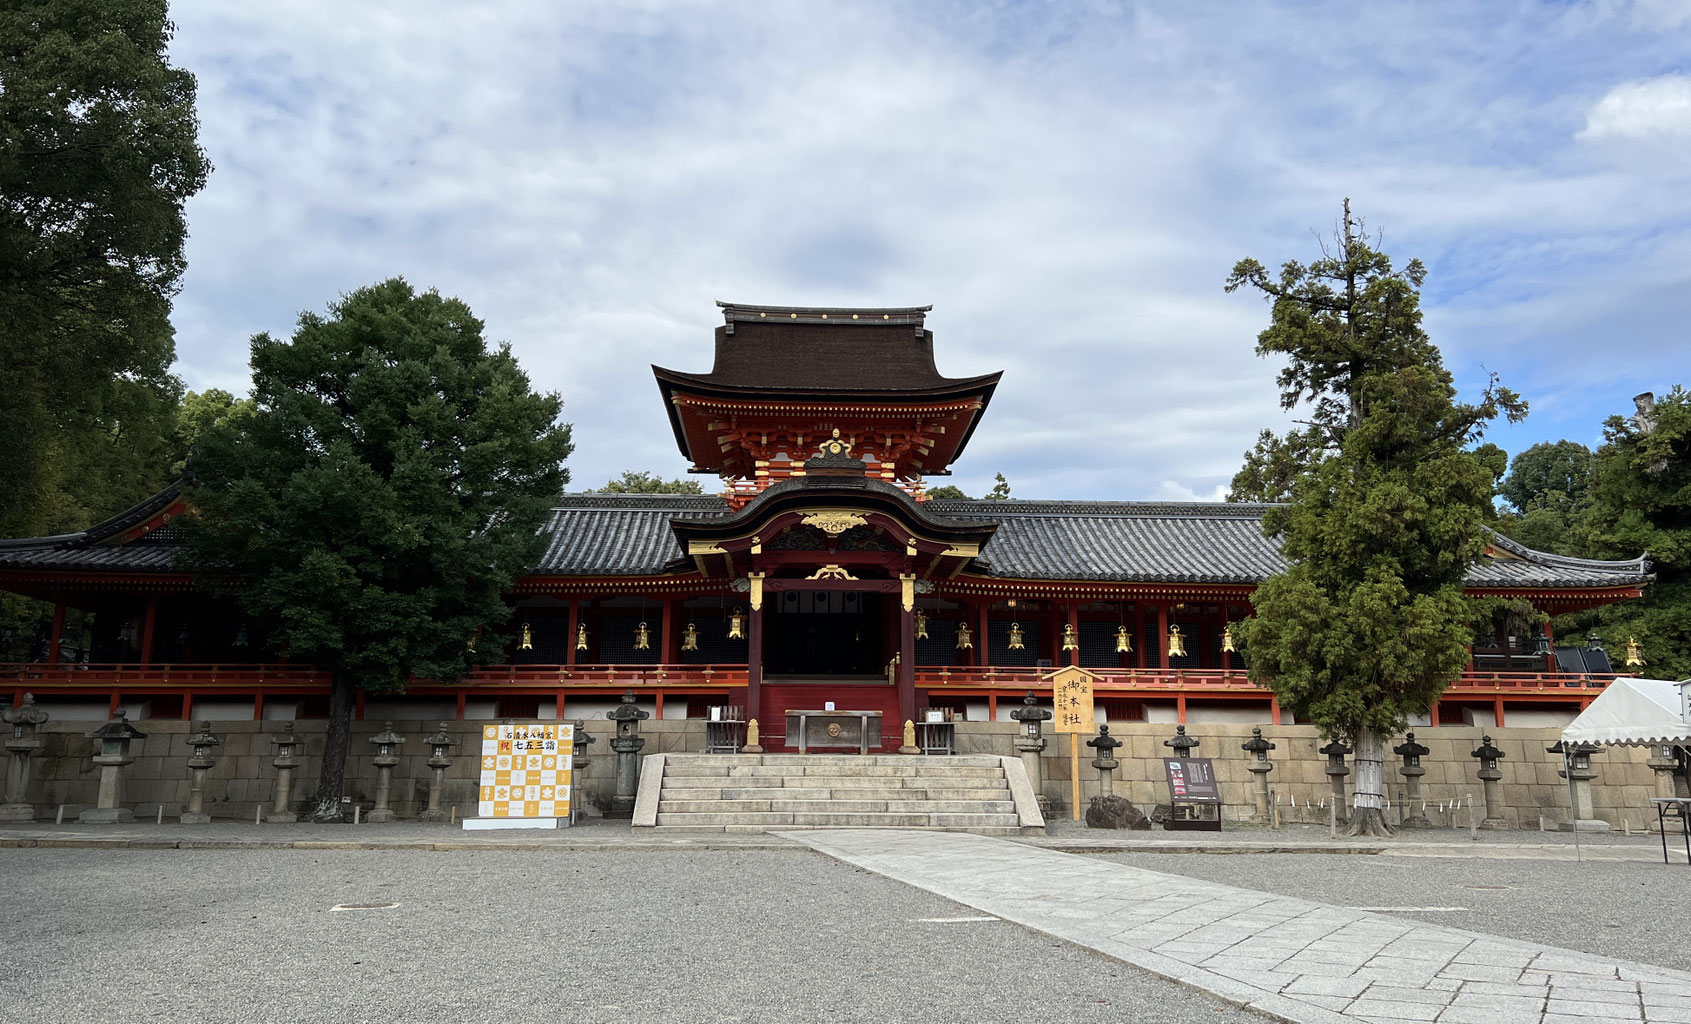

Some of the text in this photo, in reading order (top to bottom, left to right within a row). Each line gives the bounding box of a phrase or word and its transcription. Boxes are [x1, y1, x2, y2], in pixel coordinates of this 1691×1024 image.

[1068, 680, 1081, 724] 御本社
[501, 741, 510, 750] 祝
[514, 741, 555, 750] 七五三詣
